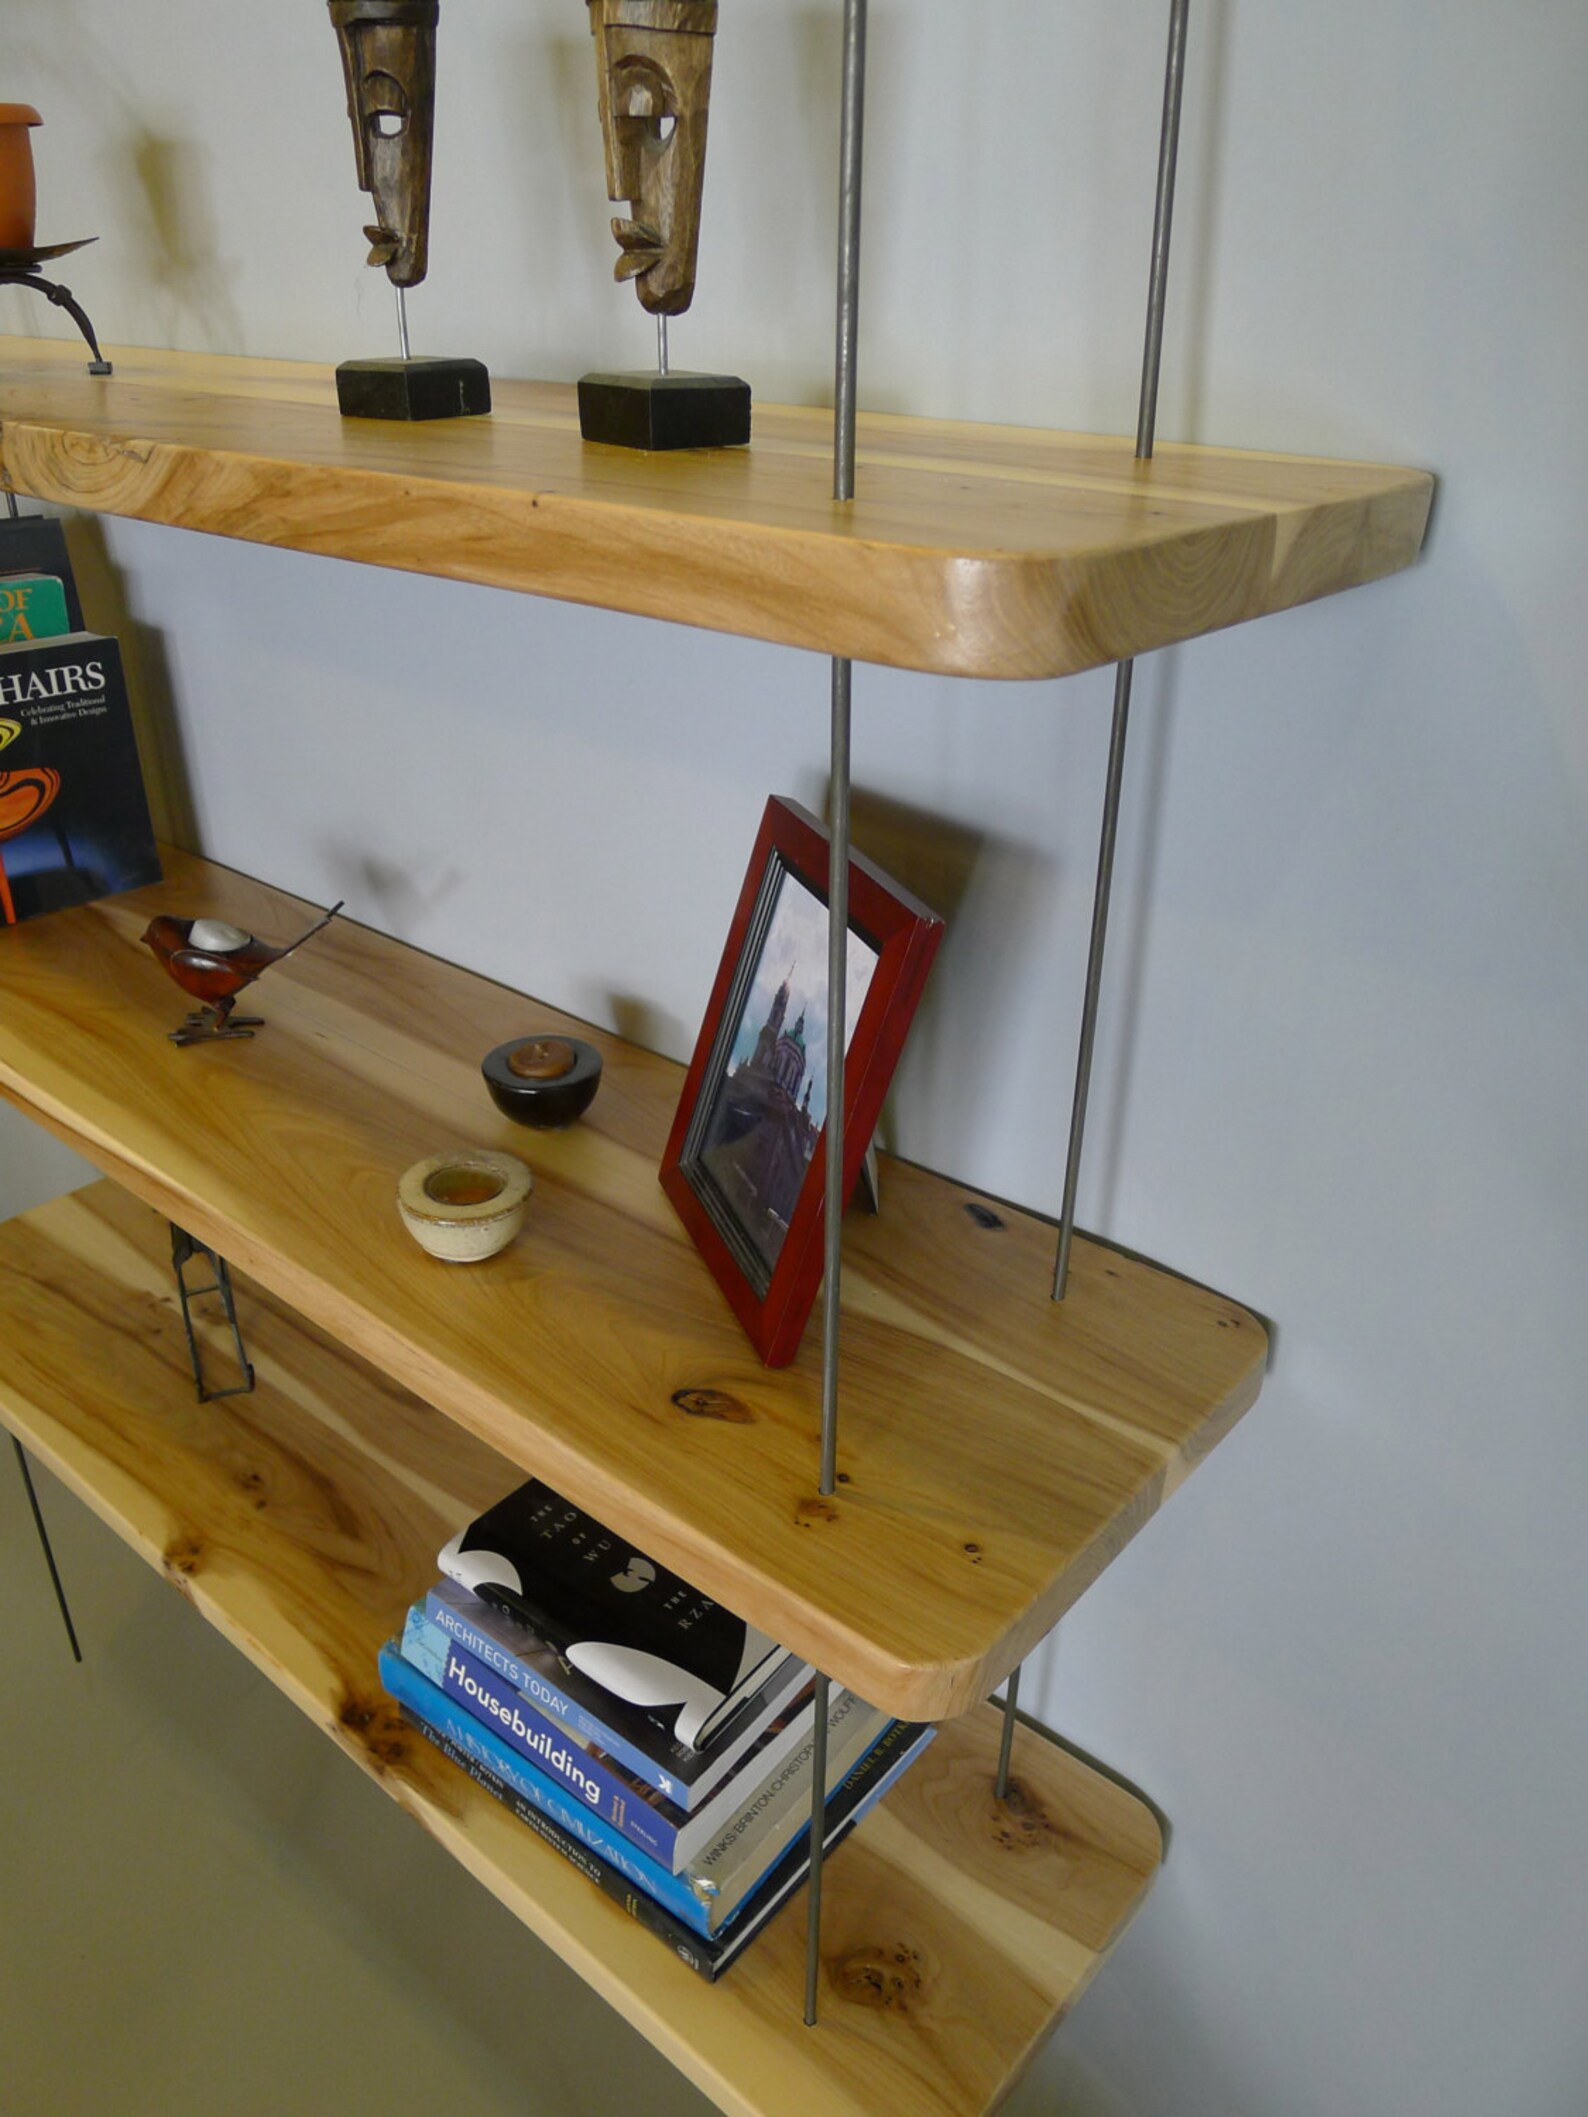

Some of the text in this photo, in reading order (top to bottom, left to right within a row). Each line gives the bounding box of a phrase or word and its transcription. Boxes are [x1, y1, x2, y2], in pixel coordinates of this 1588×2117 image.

[20, 694, 106, 718] Celebrating Traditional
[39, 711, 77, 724] Innovative
[530, 1504, 553, 1523] THE
[539, 1511, 577, 1540] TAO
[583, 1539, 612, 1563] WU
[664, 1590, 688, 1611] THE
[677, 1598, 715, 1631] RZA
[435, 1609, 519, 1680] ARCHITECTS
[522, 1672, 569, 1716] TODAY
[449, 1655, 601, 1805] Housebuilding
[420, 1720, 440, 1746] The
[442, 1743, 467, 1769] Blue
[468, 1765, 504, 1801] Planet
[526, 1807, 588, 1865] INTRODUCTION
